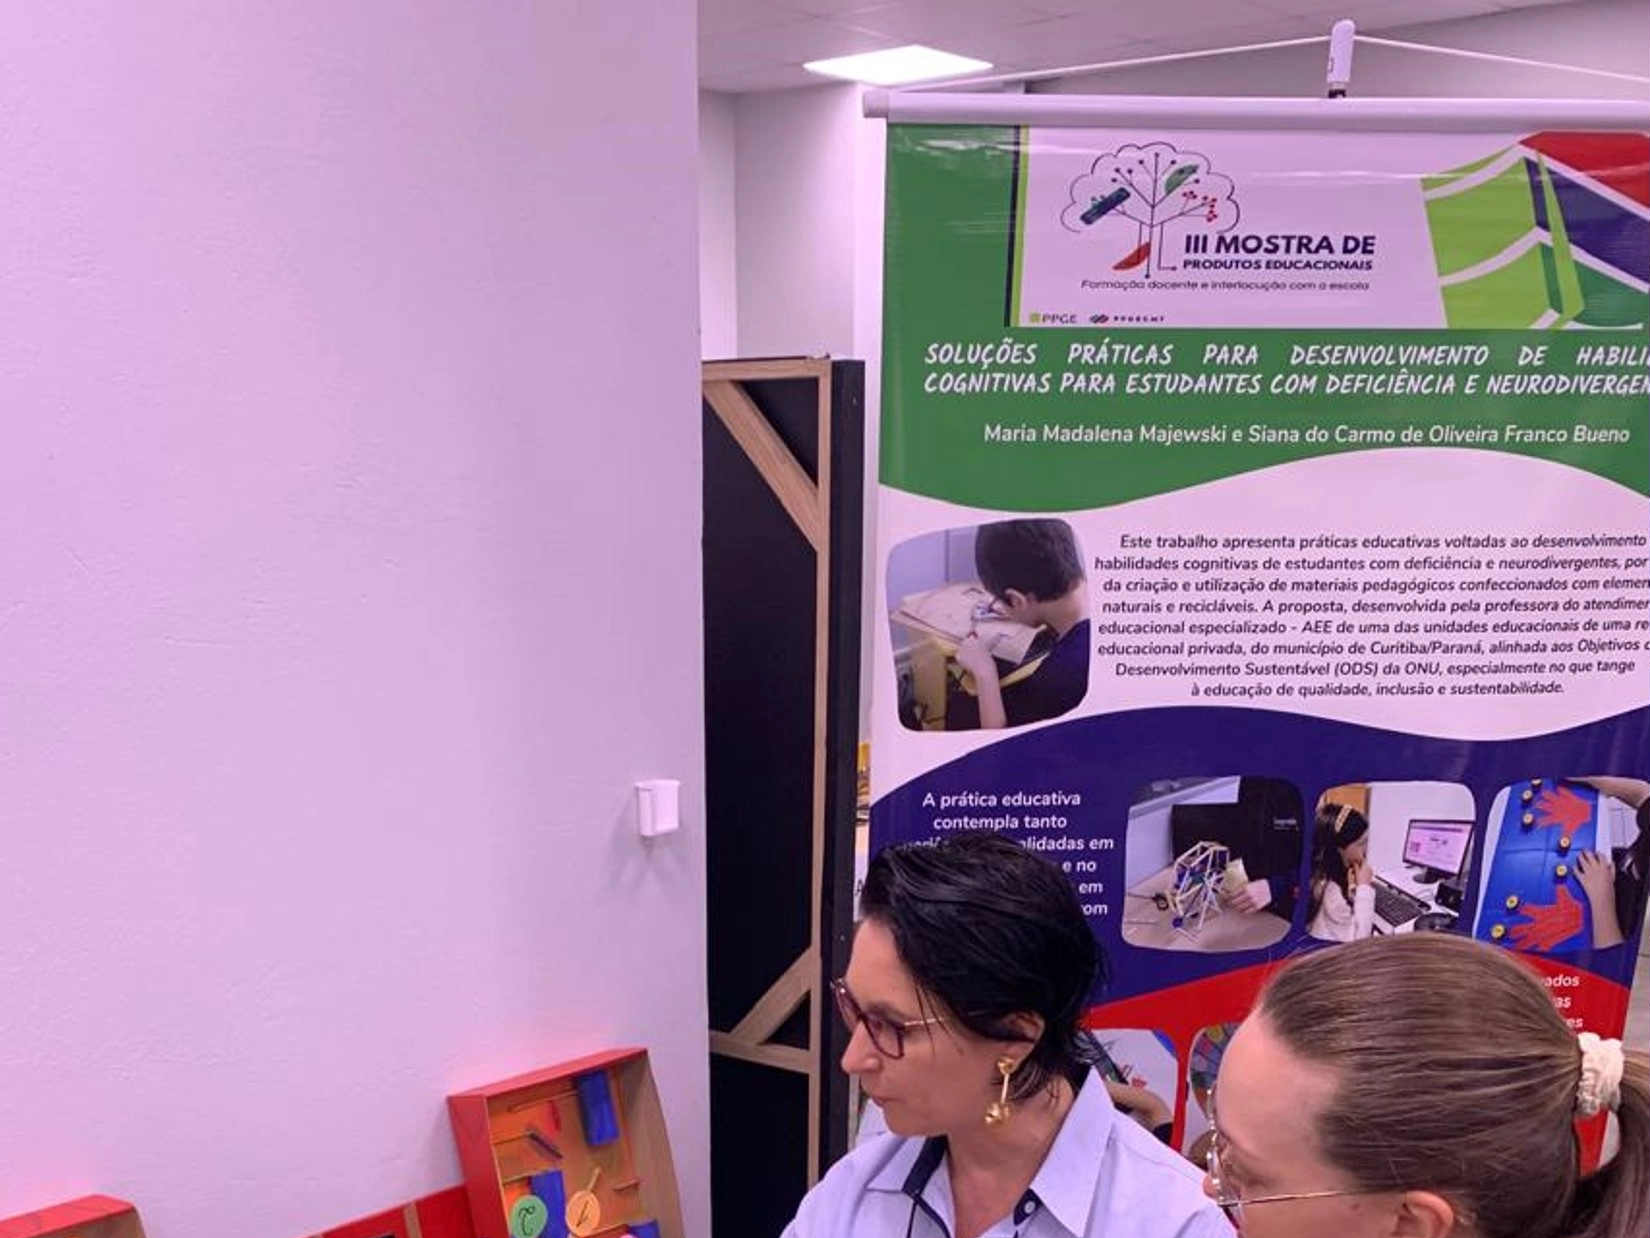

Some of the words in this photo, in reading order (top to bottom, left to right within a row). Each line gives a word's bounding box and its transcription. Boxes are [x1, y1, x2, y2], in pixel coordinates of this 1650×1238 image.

[1184, 234, 1208, 254] III
[1216, 234, 1336, 255] MOSTRA
[1342, 236, 1376, 255] DE
[1183, 259, 1262, 271] PRODUTOS
[1265, 259, 1374, 271] EDUCACIONAIS
[1081, 279, 1145, 292] Formação
[1147, 279, 1199, 291] docente
[1288, 282, 1318, 290] com
[1330, 281, 1370, 290] escola
[924, 337, 1039, 369] SOLUÇÕES
[1067, 336, 1175, 365] PRÁTICAS
[1202, 343, 1259, 365] PARA
[1290, 345, 1490, 366] DESENVOLVIMENTO
[1518, 345, 1549, 366] DE
[1575, 345, 1650, 366] HABILI
[924, 371, 1052, 395] COGNITIVAS
[1059, 372, 1117, 394] PARA
[1125, 373, 1263, 394] ESTUDANTES
[1269, 374, 1317, 395] COM
[1325, 369, 1456, 395] DEFICIÊNCIA
[1464, 374, 1480, 394] E
[984, 423, 1037, 442] Maria
[1042, 423, 1133, 442] Madalena
[1139, 423, 1226, 446] Majewski
[1232, 429, 1243, 442] e
[1249, 424, 1300, 443] Siana
[1304, 425, 1329, 443] do
[1335, 425, 1396, 443] Carmo
[1400, 425, 1423, 443] de
[1429, 424, 1499, 443] Oliveira
[1504, 425, 1568, 443] Franco
[1573, 425, 1630, 443] Bueno
[1120, 534, 1151, 549] Este
[1157, 534, 1218, 549] trabalho
[1222, 536, 1295, 552] apresenta
[1299, 534, 1358, 552] práticas
[1362, 535, 1441, 549] educativas
[1445, 535, 1506, 549] voltadas
[1510, 537, 1529, 549] ao
[1532, 534, 1647, 549] desenvolvimento
[1094, 556, 1179, 570] habilidades
[1183, 557, 1258, 573] cognitivas
[1262, 557, 1281, 570] de
[1285, 557, 1365, 570] estudantes
[1369, 559, 1399, 570] com
[1404, 557, 1482, 570] deficiência
[1486, 559, 1496, 570] e
[1499, 556, 1622, 572] neurodivergentes,
[1624, 557, 1648, 571] por
[1103, 578, 1122, 592] da
[1125, 578, 1179, 595] criação
[1181, 581, 1191, 592] e
[1194, 578, 1264, 595] utilização
[1268, 578, 1287, 592] de
[1291, 578, 1359, 592] materiais
[1362, 577, 1455, 595] pedagógicos
[1459, 577, 1568, 592] confeccionados
[1572, 579, 1599, 591] com
[1102, 600, 1162, 613] naturais
[1166, 603, 1175, 613] e
[1178, 599, 1258, 613] recicláveis.
[1262, 600, 1274, 612] A
[1278, 601, 1348, 616] proposta,
[1352, 599, 1447, 613] desenvolvida
[1450, 599, 1481, 616] pela
[1484, 598, 1559, 615] professora
[1562, 598, 1580, 612] do
[1098, 620, 1185, 634] educacional
[1189, 620, 1287, 637] especializado
[1302, 621, 1332, 634] AEE
[1336, 620, 1355, 633] de
[1358, 622, 1390, 633] uma
[1394, 620, 1419, 633] das
[1423, 619, 1488, 633] unidades
[1492, 618, 1580, 632] educacionais
[1582, 618, 1599, 631] de
[1602, 620, 1631, 631] uma
[1098, 642, 1184, 655] educacional
[1187, 642, 1247, 659] privada,
[1250, 642, 1269, 655] do
[1273, 641, 1344, 659] município
[1348, 642, 1365, 655] de
[1370, 640, 1485, 656] Curitiba/Paraná,
[1489, 640, 1548, 655] alinhada
[1551, 641, 1574, 653] aos
[1577, 638, 1641, 654] Objetivos
[1115, 663, 1240, 676] Desenvolvimento
[1245, 662, 1330, 676] Sustentável
[1334, 663, 1378, 678] (ODS)
[1382, 662, 1401, 675] da
[1405, 662, 1443, 677] ONU,
[1447, 660, 1547, 676] especialmente
[1549, 663, 1565, 674] no
[1568, 663, 1593, 676] que
[1597, 660, 1635, 675] tange
[1191, 683, 1200, 697] à
[1203, 683, 1272, 699] educação
[1276, 683, 1294, 697] de
[1298, 682, 1372, 699] qualidade,
[1376, 681, 1434, 696] inclusão
[1438, 685, 1446, 696] e
[1450, 681, 1564, 695] sustentabilidade.
[922, 792, 935, 807] A
[940, 791, 998, 810] prática
[1001, 791, 1081, 807] educativa
[933, 814, 1019, 832] contempla
[1024, 814, 1067, 829] tanto
[1088, 838, 1114, 850] em
[1076, 860, 1097, 872] no
[1079, 883, 1103, 894] em
